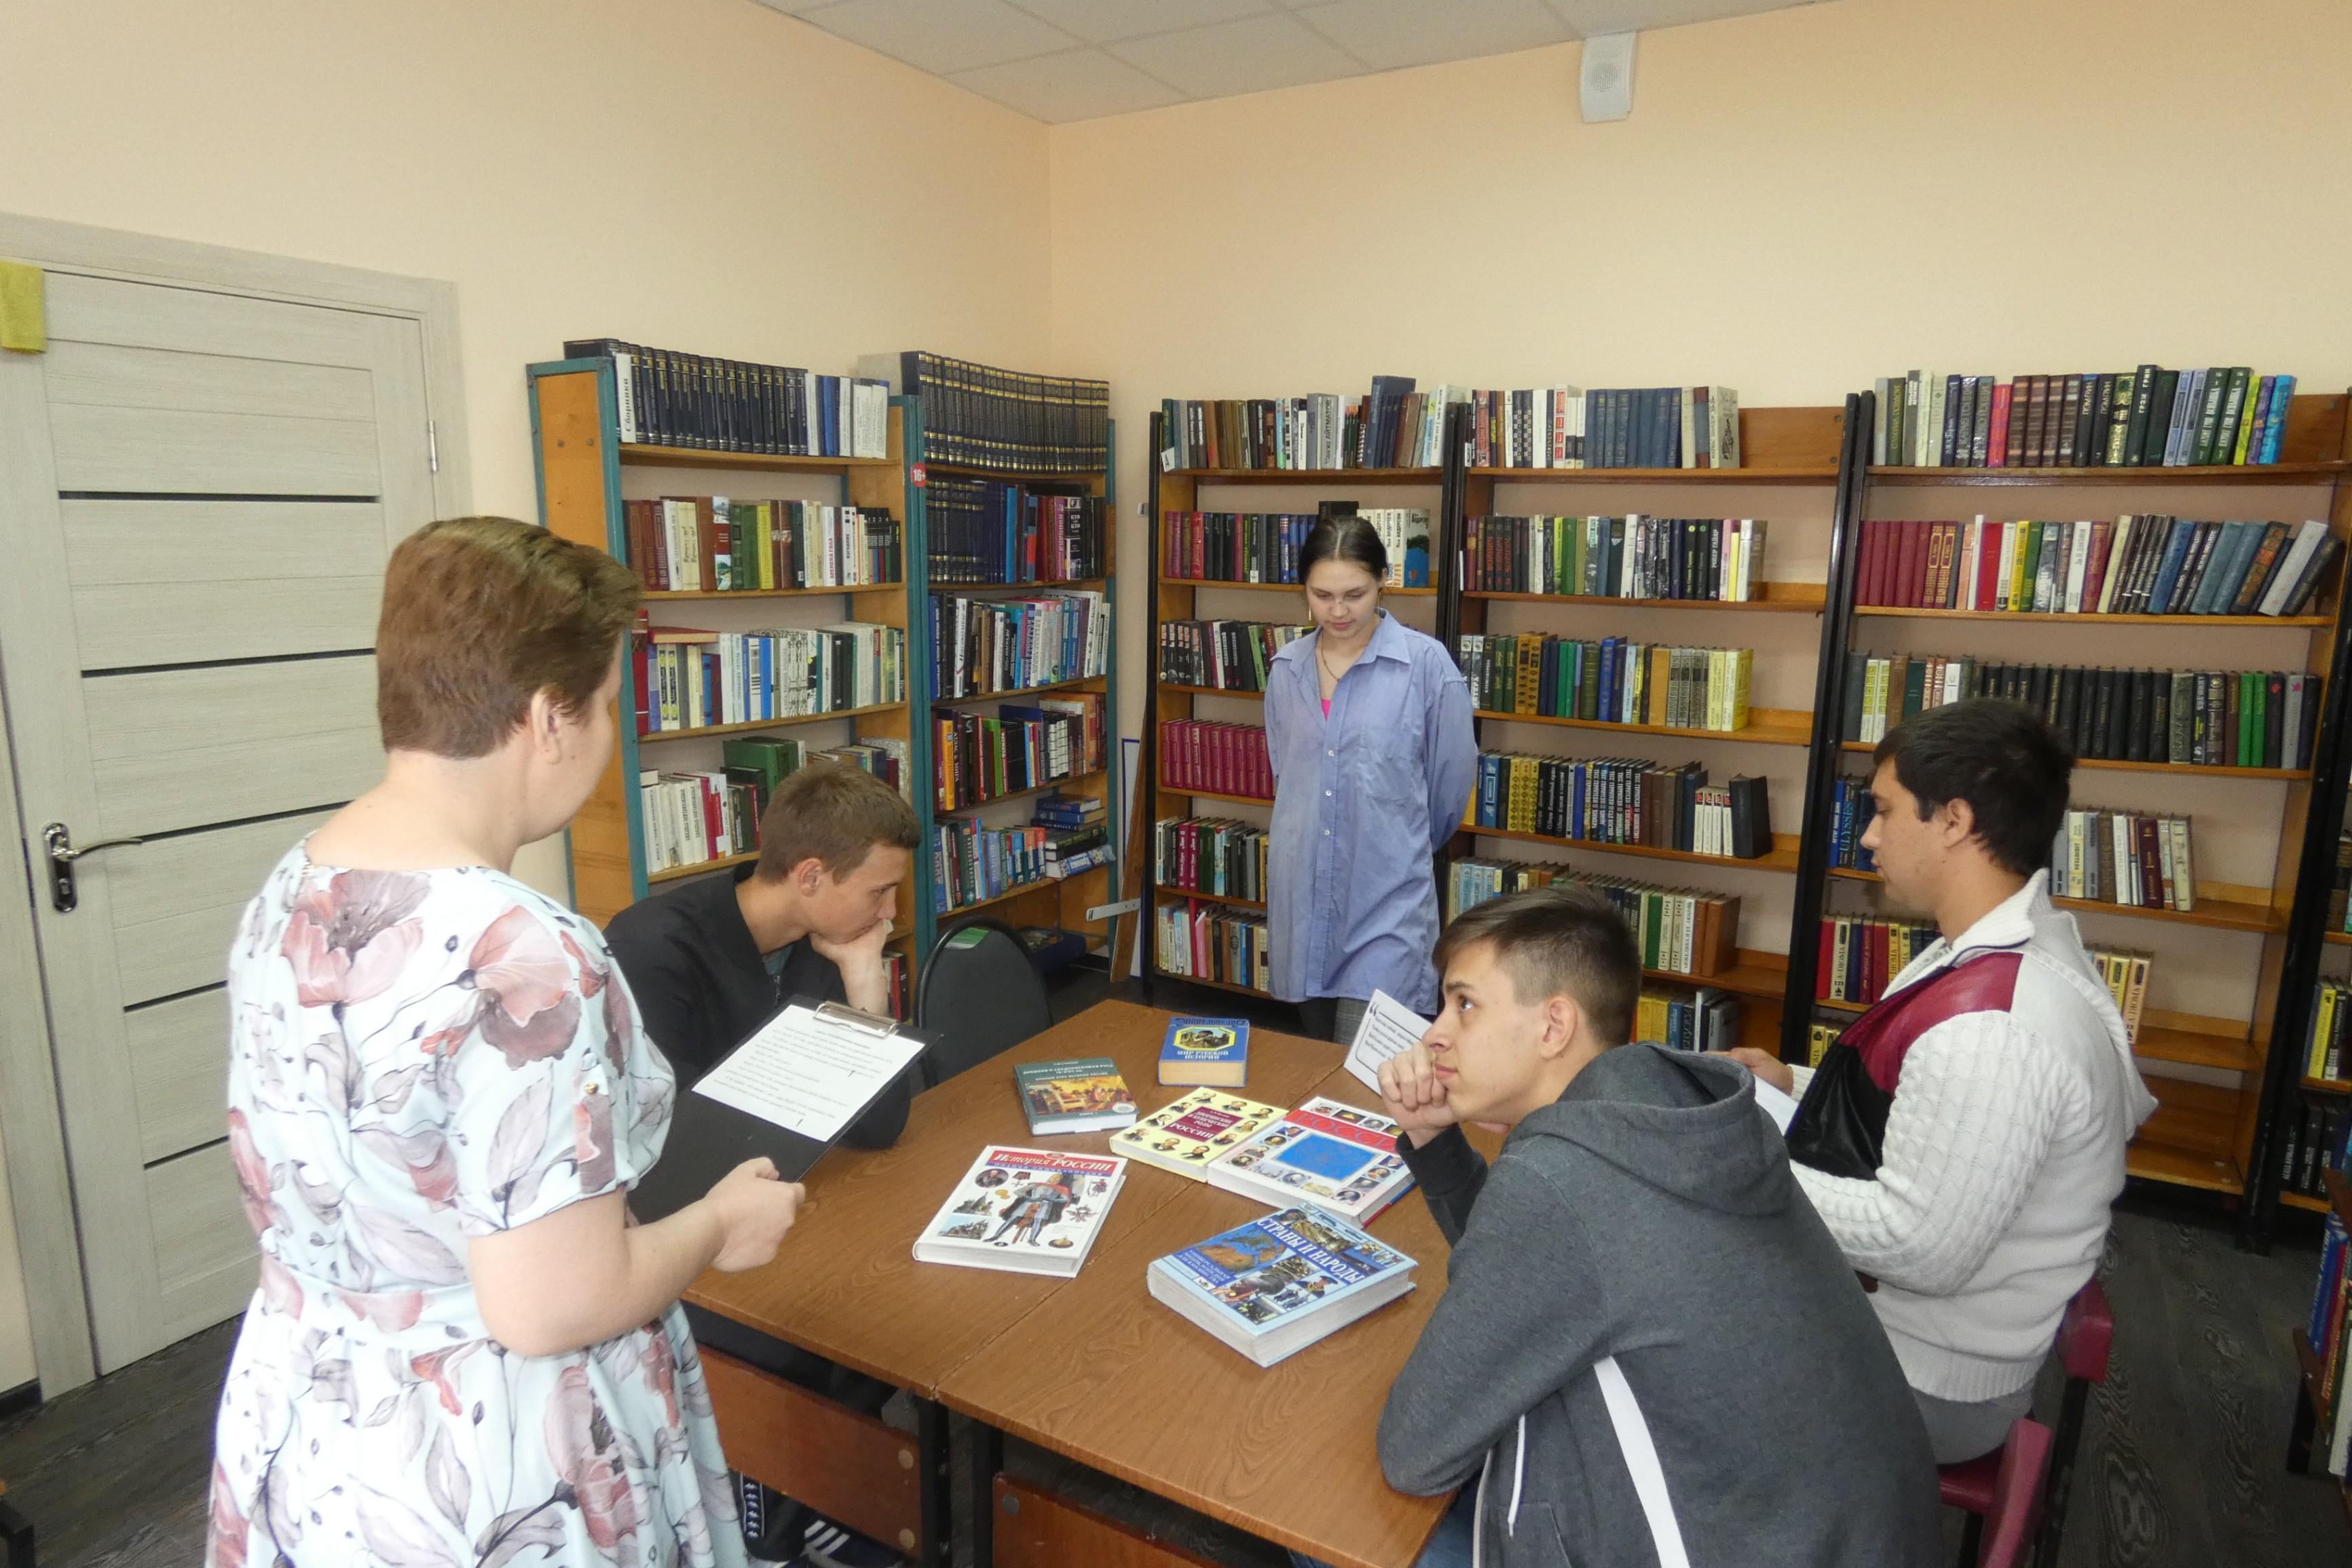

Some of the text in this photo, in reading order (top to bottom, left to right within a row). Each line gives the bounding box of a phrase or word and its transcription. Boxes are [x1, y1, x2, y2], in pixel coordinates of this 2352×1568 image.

[623, 378, 631, 432] Сборники
[2138, 369, 2151, 413] ГРЭМ ГРИН
[1323, 399, 1332, 439] АЙТМАТОВ
[913, 468, 926, 477] 16+
[1839, 802, 1853, 851] ULYSSES
[1837, 946, 1846, 972] ДЮМА
[2129, 988, 2141, 1013] ДЮМА
[1170, 1123, 1215, 1138] РОССИИ
[993, 1154, 1113, 1172] История РОССИИ
[1257, 1218, 1306, 1248] СТРАНЫ
[1311, 1248, 1366, 1284] НАРОДЫ
